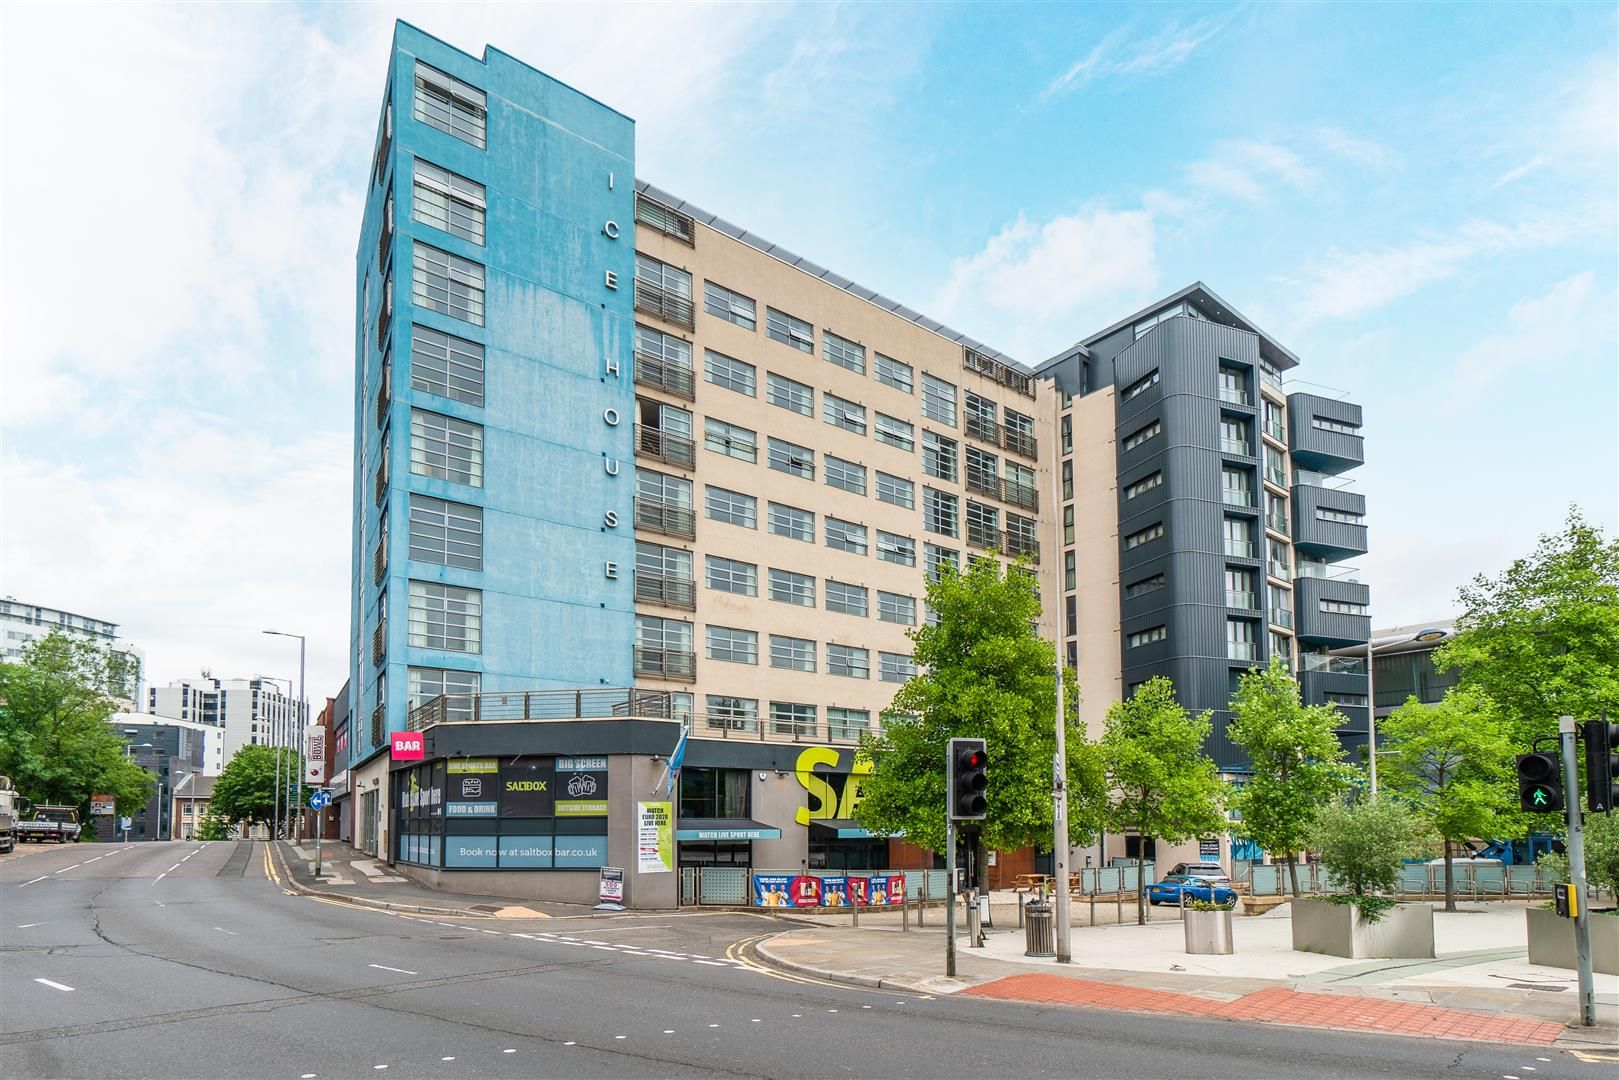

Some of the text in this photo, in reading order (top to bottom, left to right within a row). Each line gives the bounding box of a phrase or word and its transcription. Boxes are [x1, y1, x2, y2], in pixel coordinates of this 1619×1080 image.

[604, 172, 621, 579] ICE HOUSE
[312, 736, 322, 760] BOWL
[395, 741, 420, 751] BAR
[558, 758, 607, 769] BIG SCREEN
[506, 781, 547, 791] SALTBOX
[448, 805, 466, 813] FOOD
[474, 805, 496, 813] DRINK
[557, 804, 581, 812] OUTSIDE
[460, 847, 484, 857] Book
[485, 849, 507, 857] now
[509, 848, 518, 857] at
